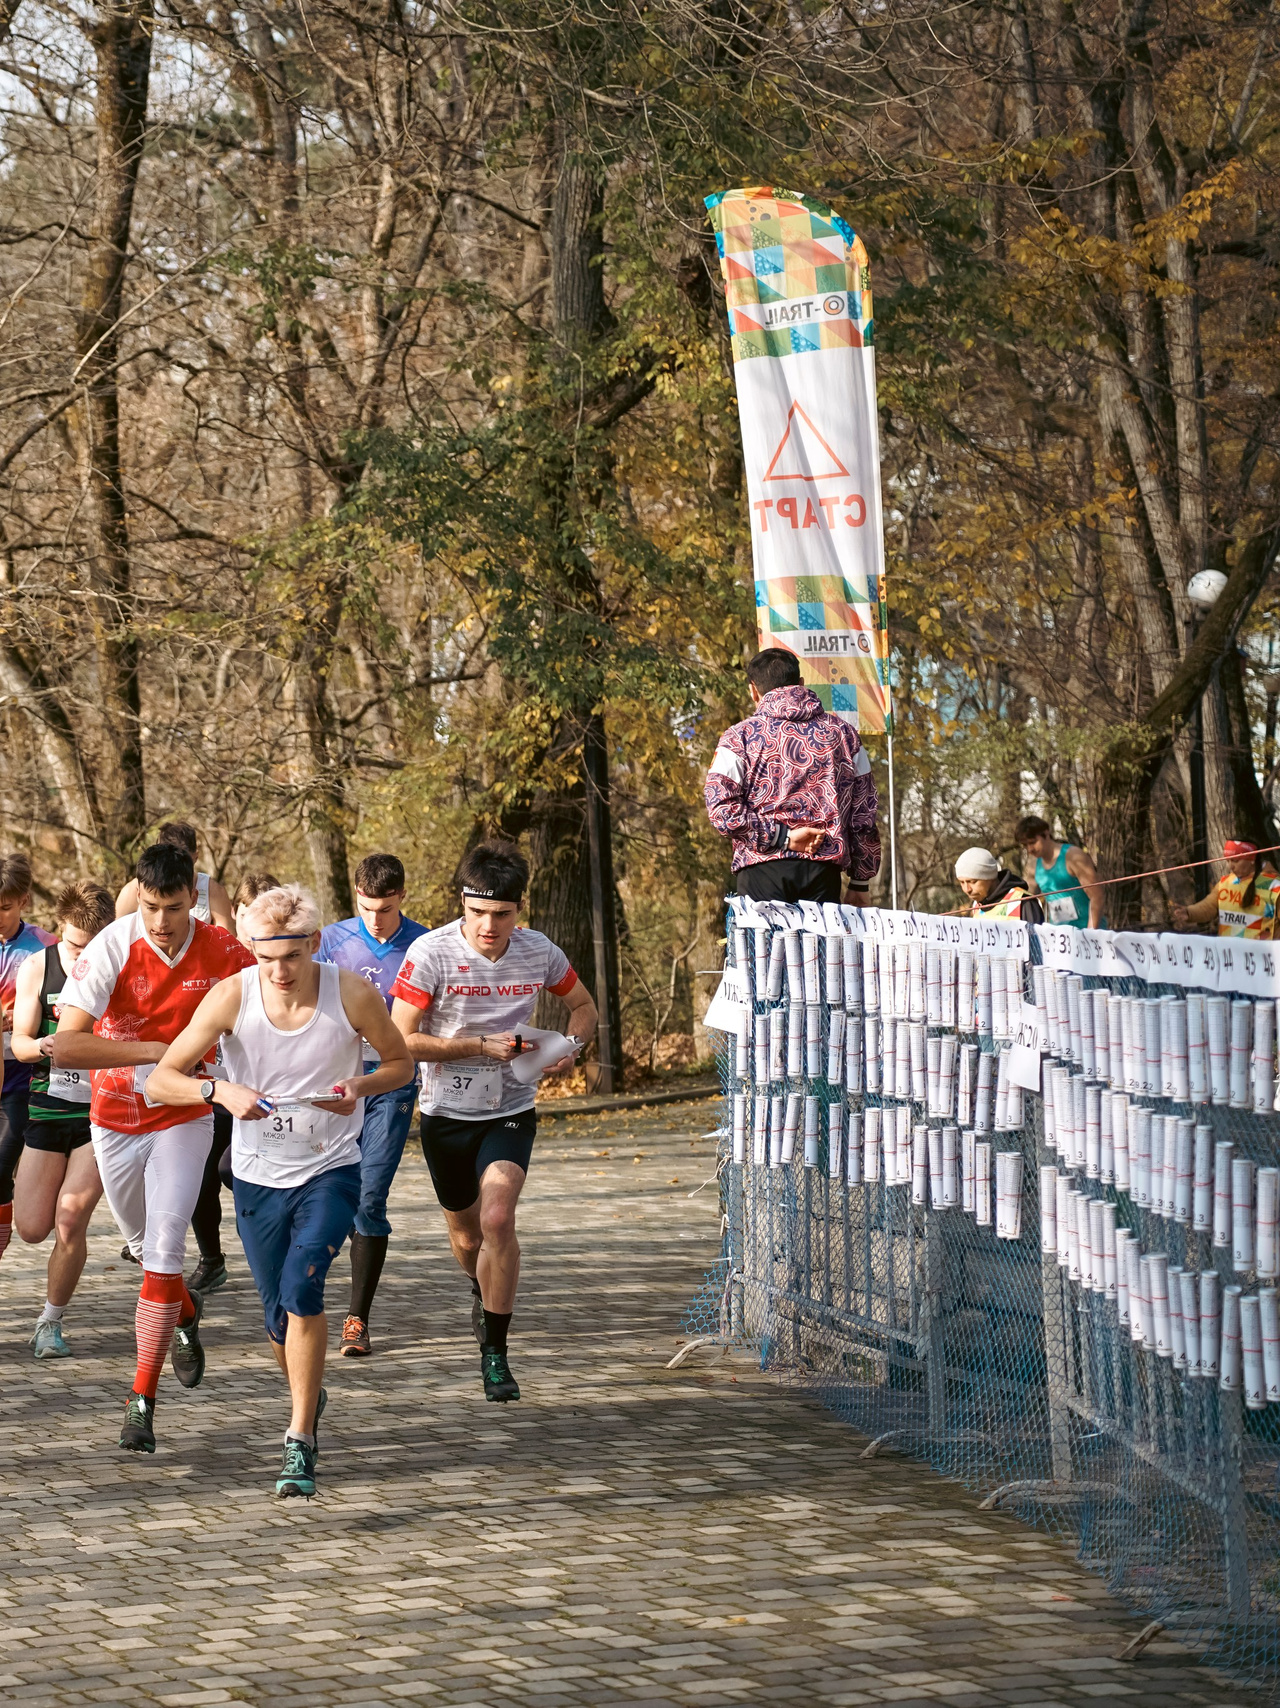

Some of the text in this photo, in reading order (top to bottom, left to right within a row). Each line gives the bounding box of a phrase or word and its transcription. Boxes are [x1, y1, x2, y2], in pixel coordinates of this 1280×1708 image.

[888, 918, 895, 935] 9
[903, 919, 914, 936] 10
[950, 925, 961, 943] 13
[986, 928, 996, 946] 15
[1183, 945, 1193, 968] 42
[1223, 948, 1233, 971] 44
[1245, 952, 1256, 976] 45
[1263, 952, 1275, 977] 46
[182, 979, 208, 987] МГТУ
[446, 983, 543, 997] NORD WEST
[64, 1071, 80, 1084] 39
[453, 1076, 473, 1090] 37
[484, 1084, 489, 1092] 1
[273, 1117, 293, 1132] 31
[309, 1124, 314, 1134] 1
[263, 1131, 286, 1140] МЖ20
